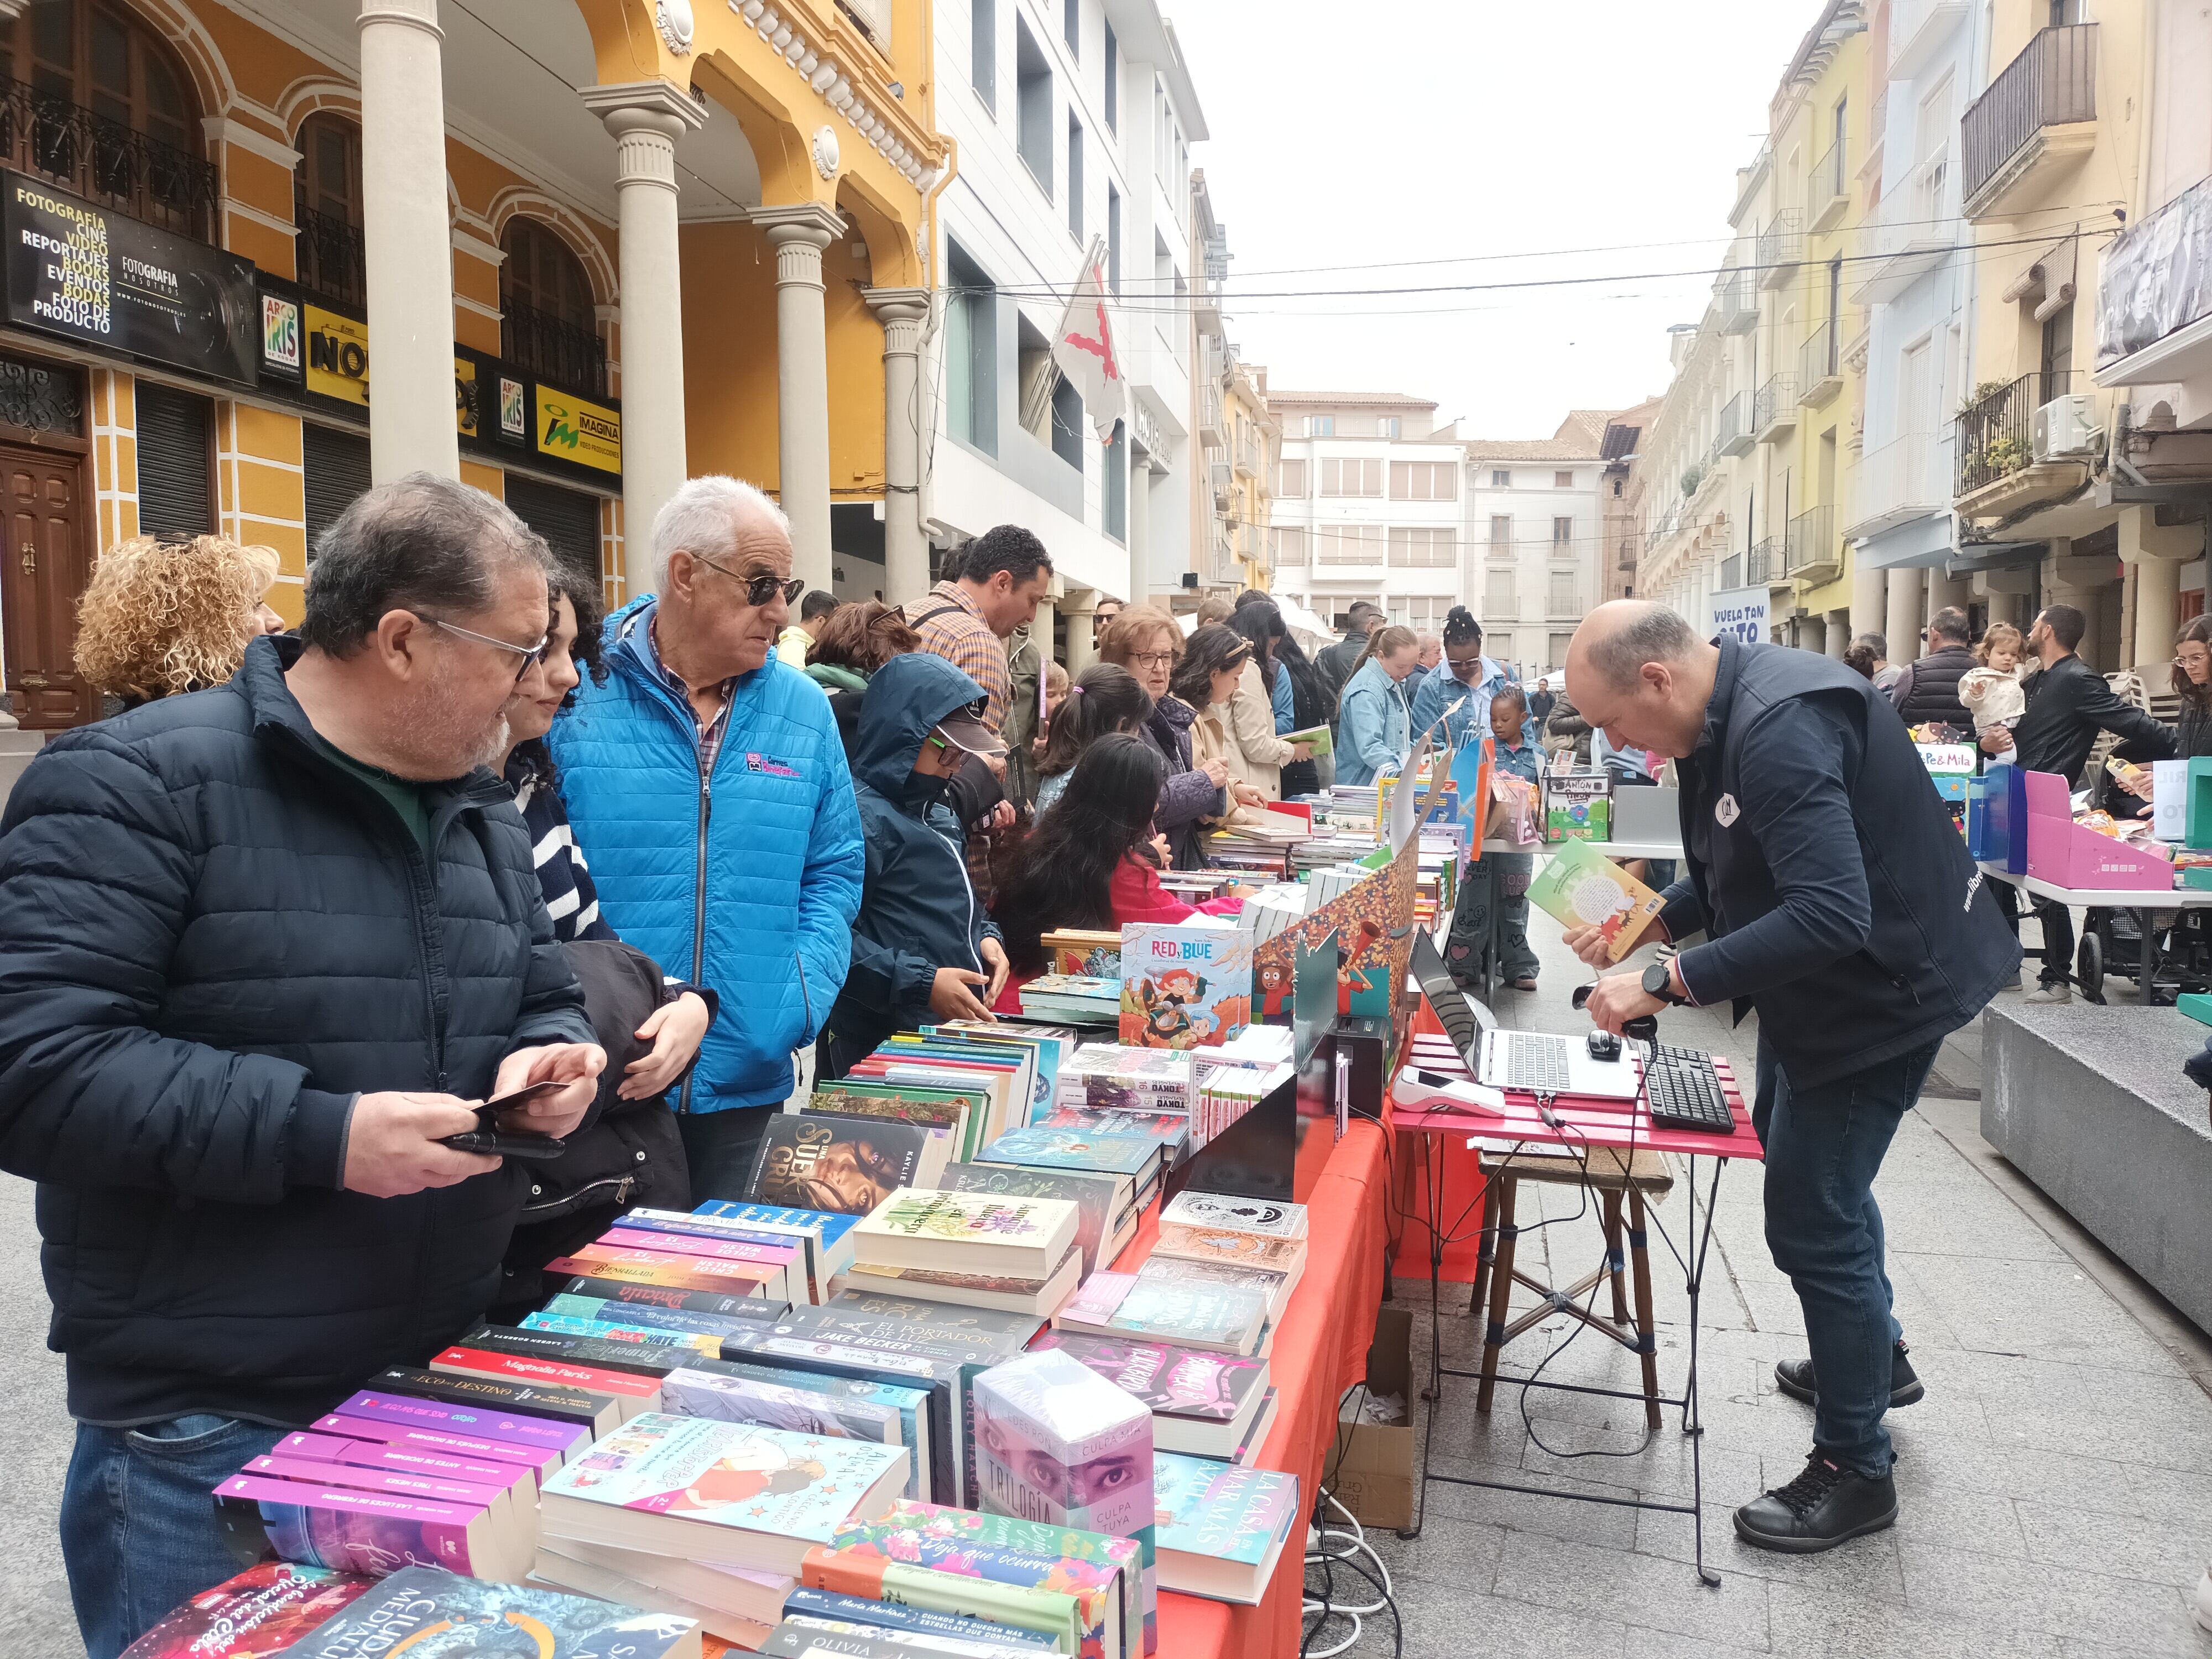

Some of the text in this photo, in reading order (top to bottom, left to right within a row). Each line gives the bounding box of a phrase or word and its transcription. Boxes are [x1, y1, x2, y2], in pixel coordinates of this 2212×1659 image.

[17, 188, 106, 231] FOTOGRAFÍA
[66, 231, 108, 257] VIDEO
[77, 223, 108, 245] CINE
[22, 229, 109, 270] REPORTAJES
[48, 264, 110, 296] EVENTOS
[63, 256, 109, 283] BOOKS
[122, 256, 178, 288] FOTOGRAFIA
[64, 282, 110, 309] BODAS
[123, 272, 179, 296] NOSOTROS
[34, 300, 111, 334] PRODUCTO
[53, 292, 111, 321] FOTO DE
[267, 300, 295, 320] ARCO
[267, 314, 296, 358] IRIS
[503, 381, 521, 397] ARCO
[502, 393, 522, 427] IRIS
[579, 416, 619, 439] IMAGINA
[579, 441, 619, 459] VIDEO PRODUCCIONES
[1714, 605, 1764, 623] VUELA TAN
[1500, 873, 1531, 885] GOOD
[1152, 941, 1213, 959] RED y BLUE
[1144, 1095, 1152, 1106] 15
[1156, 1099, 1186, 1109] TOKYO
[818, 1145, 829, 1160] UNA
[900, 1151, 914, 1181] KAYLIE
[904, 1192, 953, 1234] primavera
[948, 1208, 966, 1219] en
[970, 1204, 1006, 1228] llueva
[1001, 1203, 1039, 1234] Aunque
[715, 1248, 757, 1258] CHLOE
[719, 1243, 762, 1254] WALSH
[691, 1264, 734, 1275] CHLOE
[697, 1260, 739, 1270] WALSH
[699, 1319, 721, 1328] cosas
[876, 1322, 996, 1348] EL PORTADOR
[494, 1334, 527, 1343] ROBERTS
[816, 1332, 853, 1343] JAKE
[854, 1336, 912, 1351] BECKER
[869, 1329, 933, 1344] DE LUZ
[921, 1348, 953, 1358] SIEMPRE
[501, 1360, 593, 1381] Magnolia Parks
[416, 1375, 445, 1386] ECO
[453, 1381, 512, 1396] DESTINO
[1082, 1435, 1117, 1457] CULPA
[434, 1459, 462, 1468] ANTES
[836, 1446, 873, 1479] OSEMAN
[855, 1452, 888, 1478] ALICE
[411, 1481, 432, 1489] TRES
[988, 1459, 1051, 1525] TRILOGÍA
[1183, 1461, 1222, 1501] AZUL
[369, 1499, 397, 1508] LUCES
[771, 1495, 800, 1524] CONTIGO
[783, 1494, 817, 1531] CRECIENDO
[1097, 1501, 1131, 1524] CULPA
[1196, 1467, 1255, 1545] MAR MÁS
[1233, 1472, 1284, 1550] LA CASA EN
[1102, 1515, 1130, 1534] TUYA
[1228, 1537, 1241, 1547] EL
[921, 1540, 1055, 1572] Deja que ocurra
[253, 1575, 307, 1605] Oficial
[230, 1602, 252, 1620] del
[236, 1589, 305, 1635] bendición
[838, 1598, 1024, 1637] María Martínez CUANDO NO QUEDEN MÁS
[315, 1587, 422, 1659] MEDIALU
[919, 1619, 1017, 1643] ESTRELLAS QUE CONTAR
[189, 1618, 233, 1653] Cielo
[812, 1636, 870, 1656] OLIVIA
